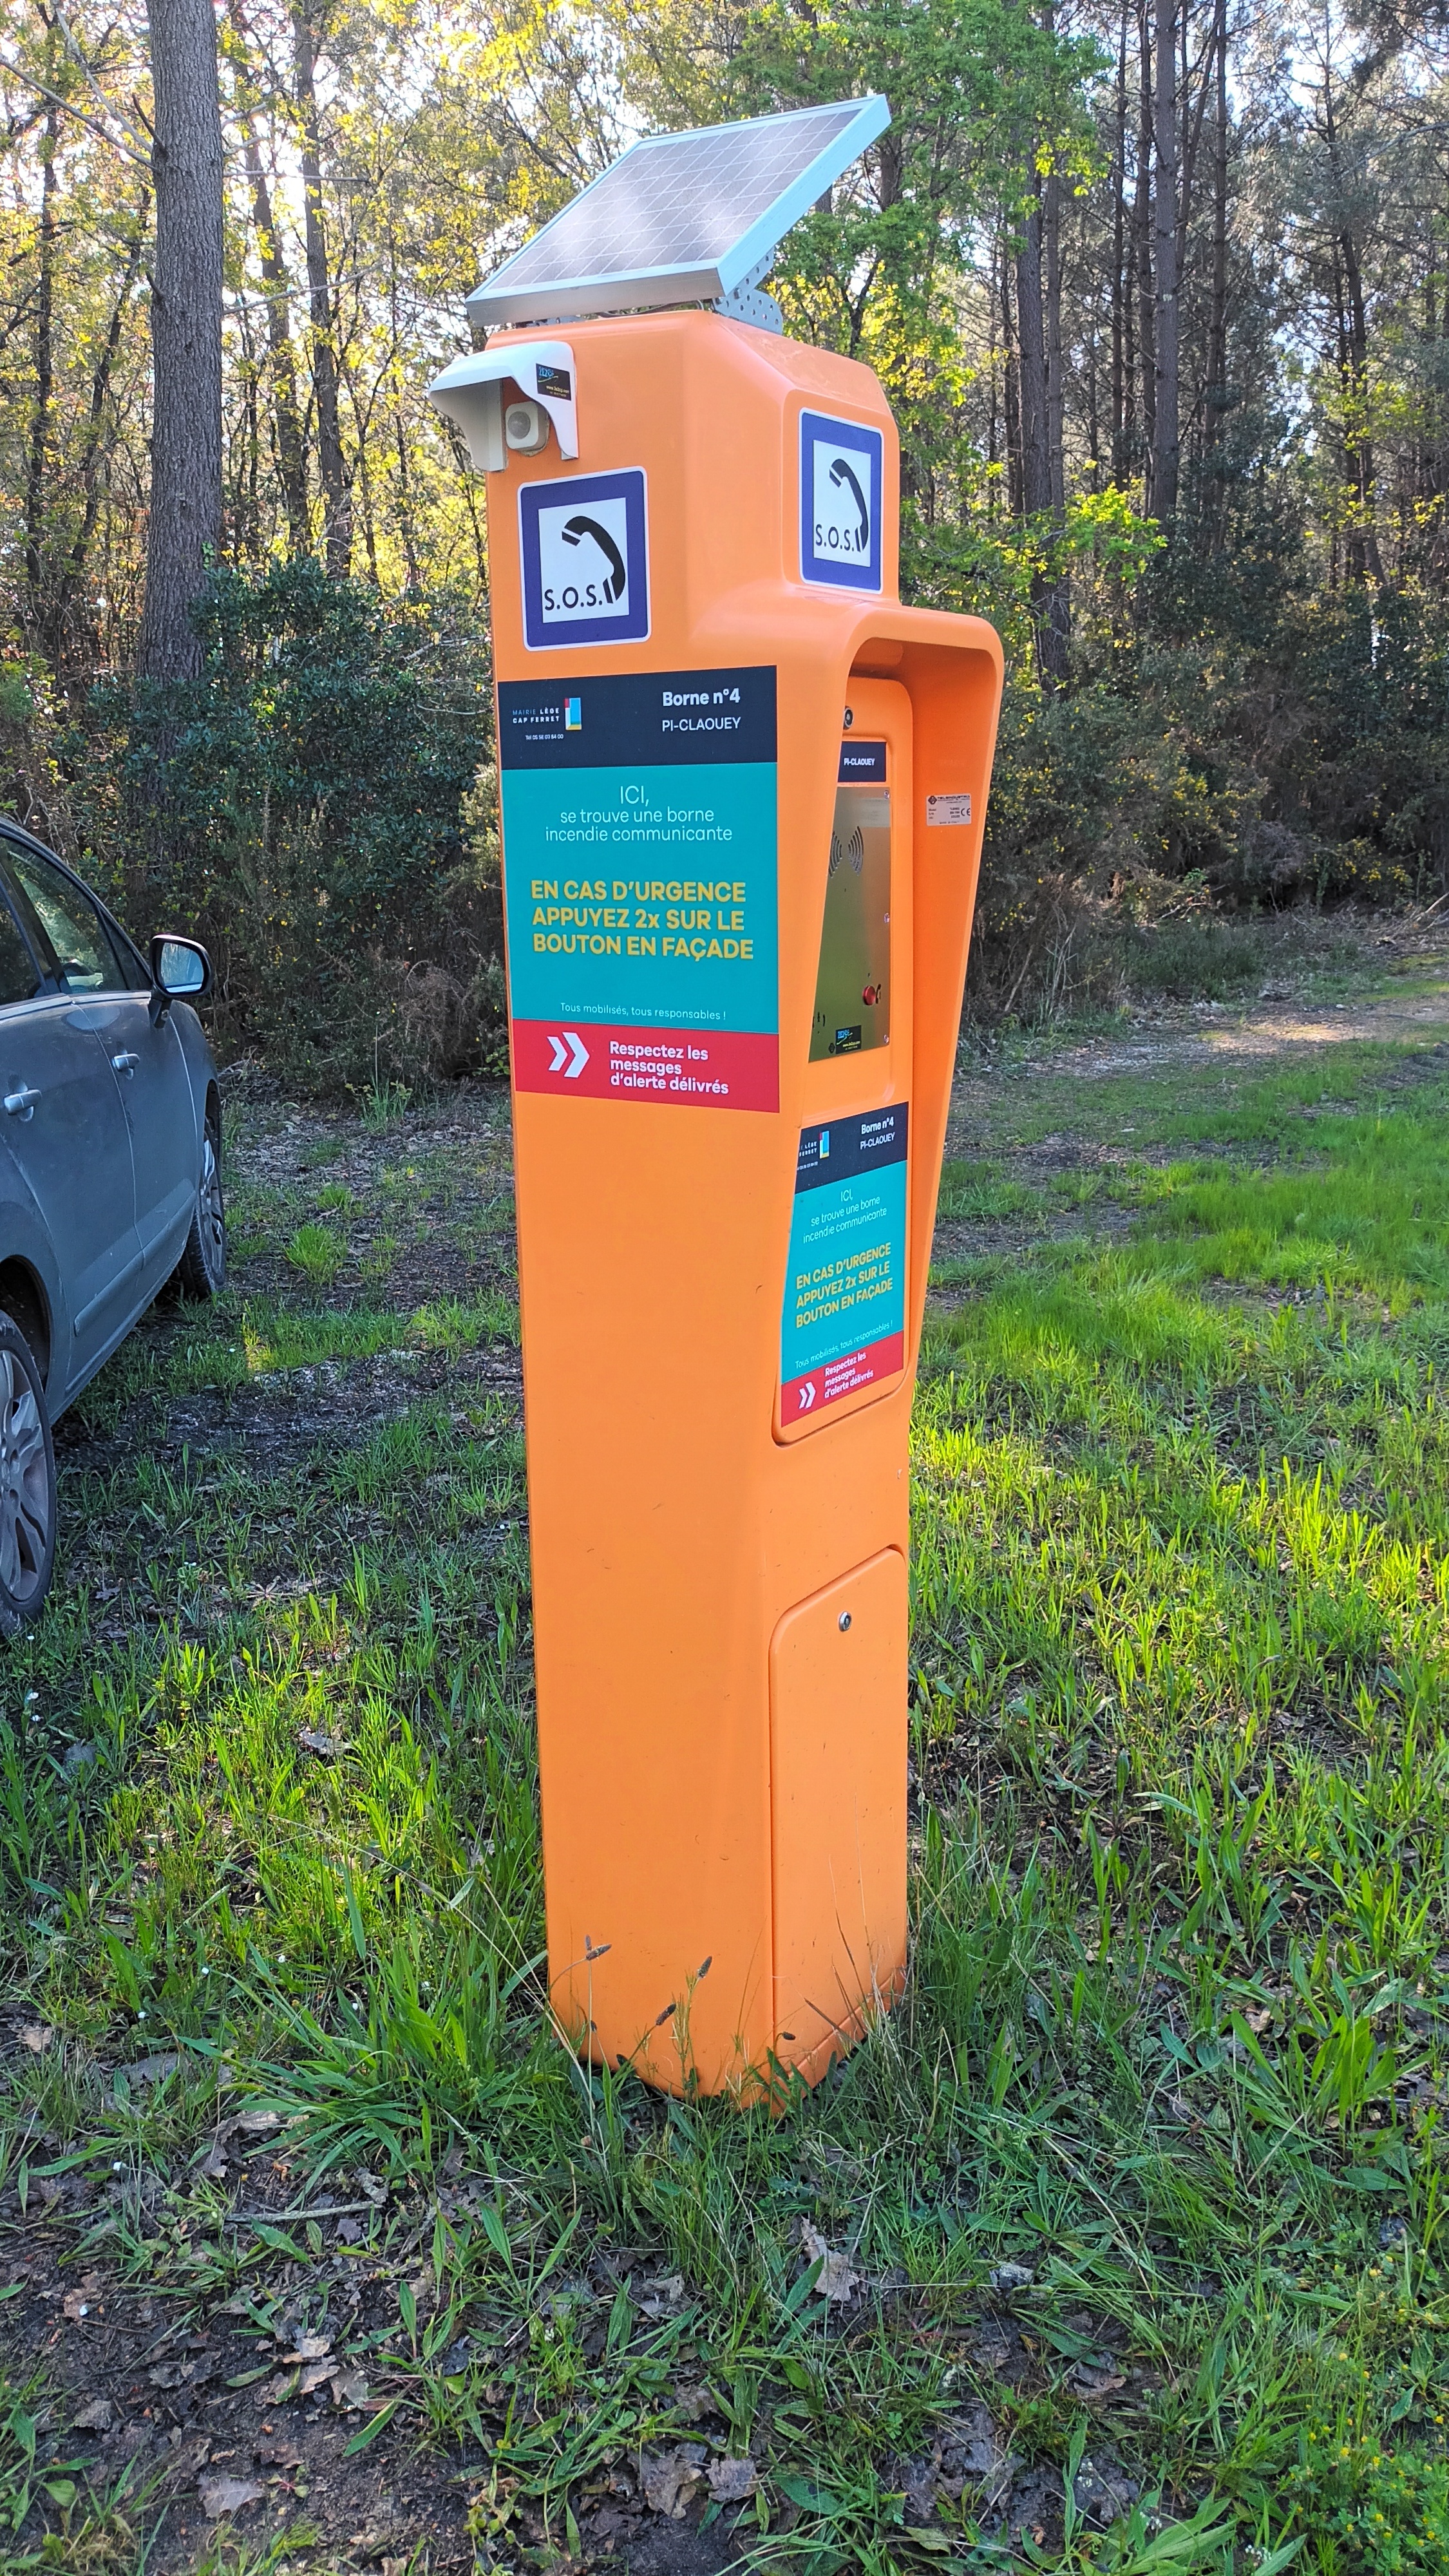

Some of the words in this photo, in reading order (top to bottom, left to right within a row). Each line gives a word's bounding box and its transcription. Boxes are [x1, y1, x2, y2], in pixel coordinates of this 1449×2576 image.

[815, 524, 855, 552] S.O.S.
[544, 584, 603, 611] S.O.S.
[663, 691, 708, 706] Borne
[713, 688, 740, 704] n°4
[662, 717, 741, 732] PI-CLAOUEY
[620, 785, 649, 807] ICI,
[560, 810, 576, 824] se
[580, 808, 629, 823] trouve
[633, 808, 663, 822] une
[667, 806, 714, 822] borne
[545, 826, 608, 842] incendie
[612, 825, 732, 841] communicante
[531, 880, 558, 899] EN
[564, 880, 607, 900] CAS
[612, 881, 746, 902] D'URGENCE
[532, 907, 629, 928] APPUYEZ
[635, 911, 660, 929] 2x
[666, 910, 711, 930] SUR
[717, 910, 744, 931] LE
[533, 933, 621, 955] BOUTON
[627, 936, 656, 956] EN
[662, 938, 753, 962] FAÇADE
[560, 1002, 581, 1013] Tous
[583, 1005, 629, 1017] mobilisés,
[631, 1006, 652, 1016] tous
[654, 1009, 721, 1021] responsables
[609, 1041, 685, 1059] Respectez
[687, 1045, 708, 1061] les
[610, 1059, 682, 1075] messages
[611, 1072, 667, 1090] d'alerte
[669, 1076, 729, 1095] délivrés
[861, 1122, 881, 1135] Borne
[882, 1116, 895, 1128] n°4
[860, 1132, 895, 1150] PI-CLAOUEY
[840, 1188, 853, 1202] ICI,
[811, 1216, 820, 1227] se
[821, 1208, 845, 1224] trouve
[846, 1203, 859, 1215] une
[860, 1195, 880, 1211] borne
[803, 1224, 835, 1244] incendie
[836, 1208, 887, 1231] communicante
[796, 1273, 811, 1289] EN
[812, 1266, 834, 1283] CAS
[836, 1242, 891, 1274] D'URGENCE
[796, 1278, 844, 1309] APPUYEZ
[845, 1275, 857, 1290] 2x
[858, 1267, 877, 1284] SUR
[878, 1261, 890, 1278] LE
[796, 1299, 839, 1329] BOUTON
[841, 1293, 854, 1310] EN
[856, 1278, 893, 1303] FAÇADE
[795, 1360, 810, 1369] Tous
[840, 1339, 853, 1349] tous
[854, 1321, 890, 1341] responsables
[825, 1356, 857, 1377] Respectez
[857, 1352, 867, 1362] les
[824, 1368, 856, 1388] messages
[849, 1368, 874, 1387] délivrés
